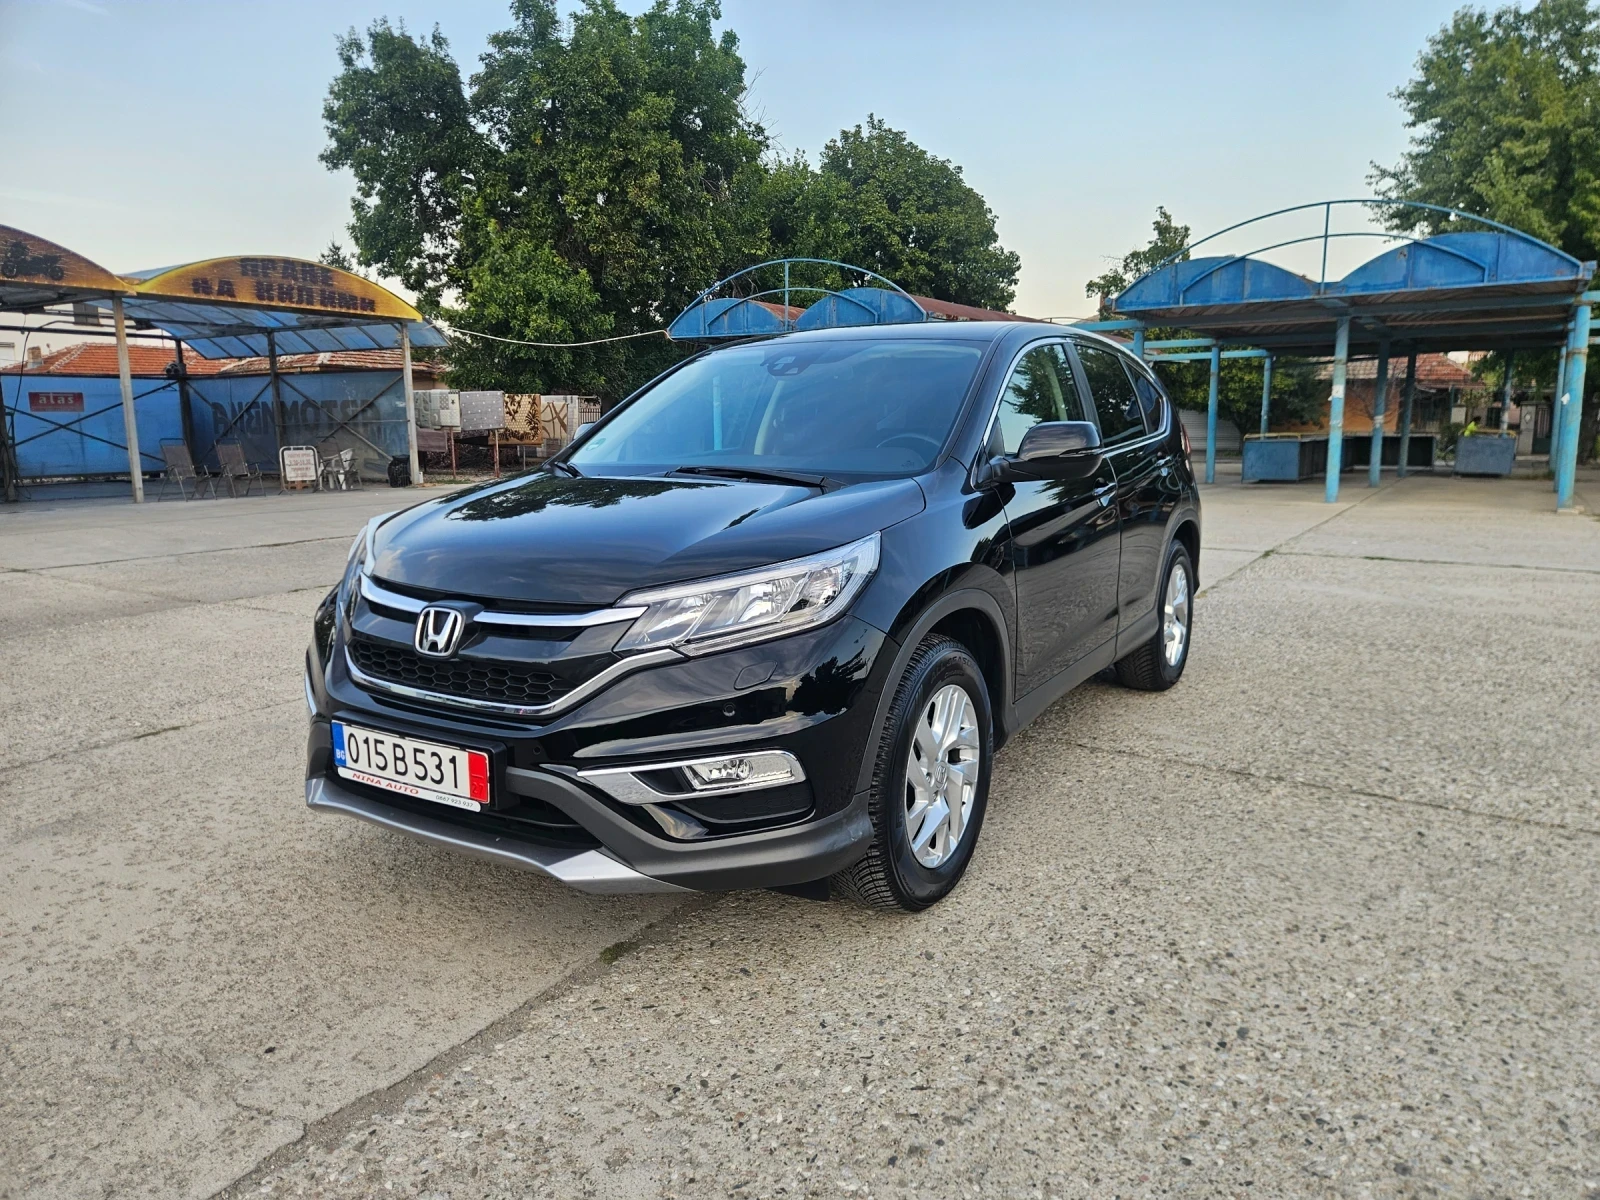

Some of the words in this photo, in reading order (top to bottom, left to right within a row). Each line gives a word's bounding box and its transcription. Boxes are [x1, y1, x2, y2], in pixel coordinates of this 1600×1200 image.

[335, 749, 346, 761] BG
[352, 773, 382, 786] NINA
[385, 782, 419, 795] AUTO
